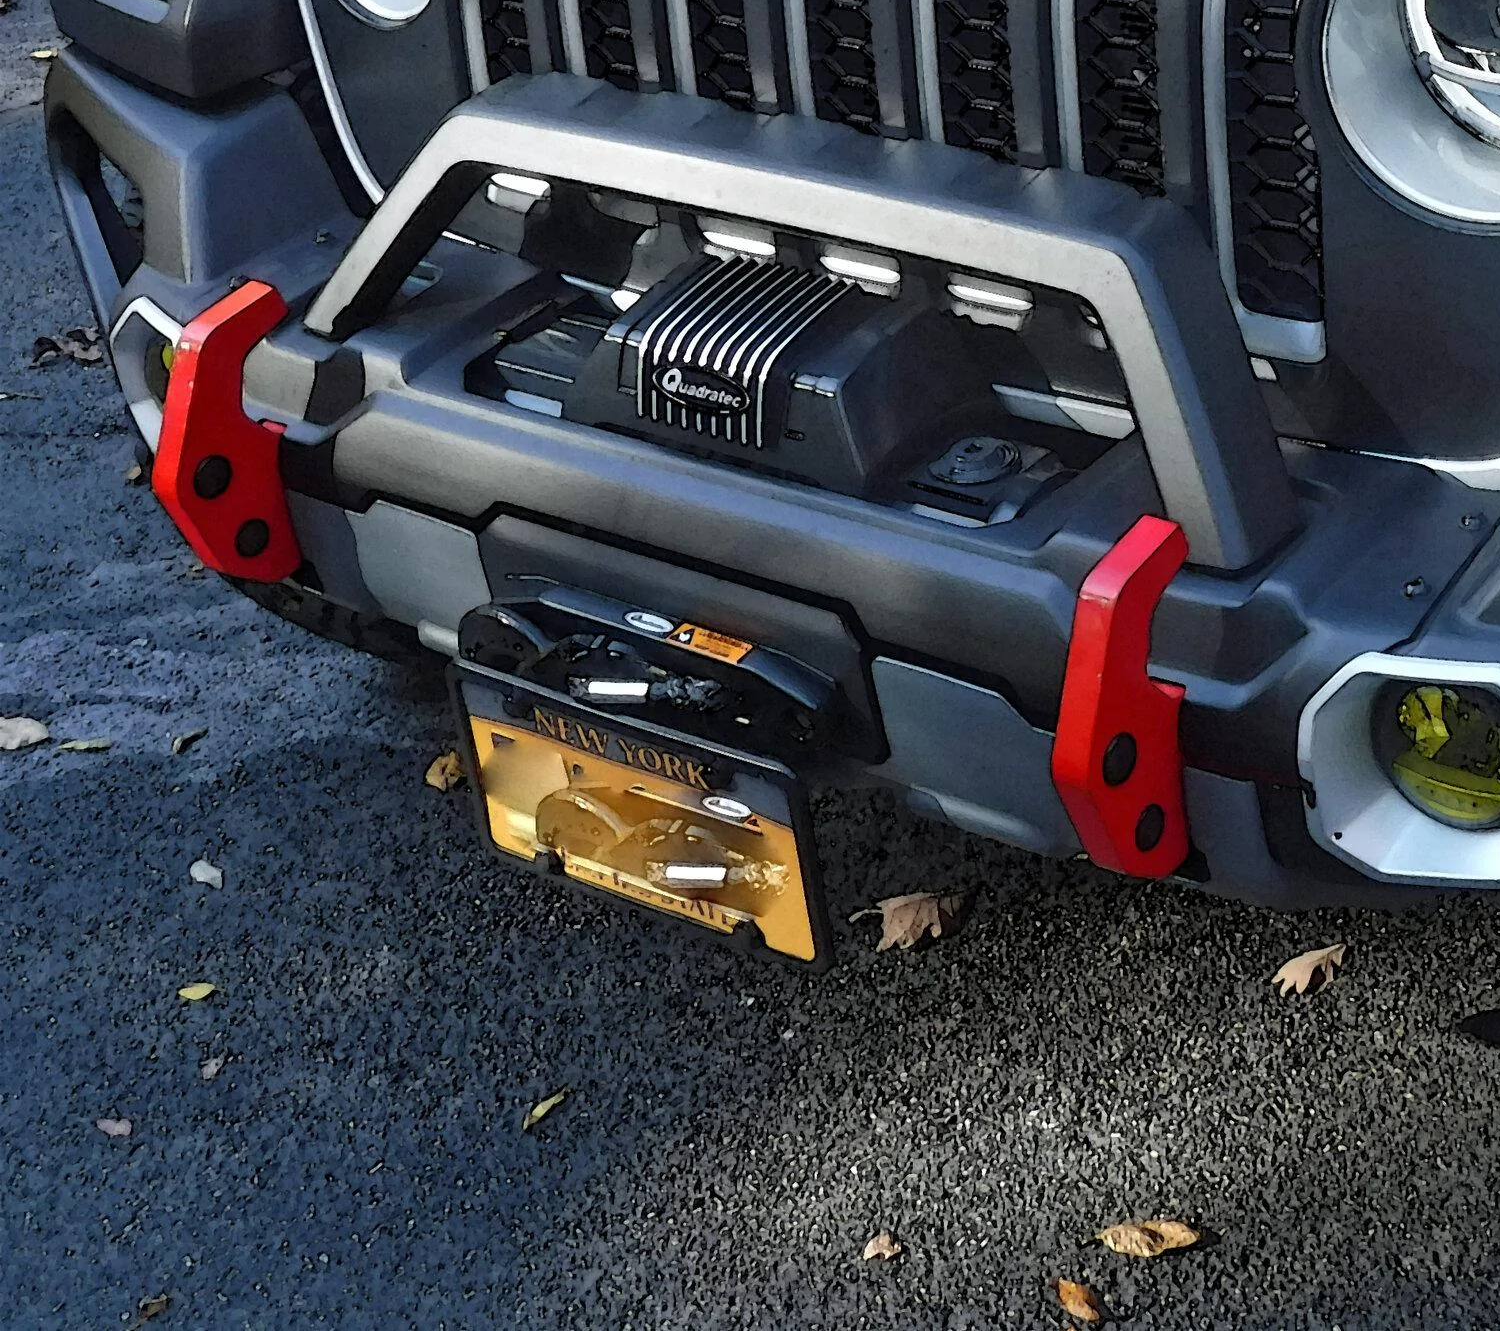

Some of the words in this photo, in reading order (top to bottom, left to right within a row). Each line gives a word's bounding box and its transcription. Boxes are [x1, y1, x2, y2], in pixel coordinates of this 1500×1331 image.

[661, 367, 742, 408] Quadratec
[533, 706, 608, 755] NEW
[617, 737, 711, 792] YORK
